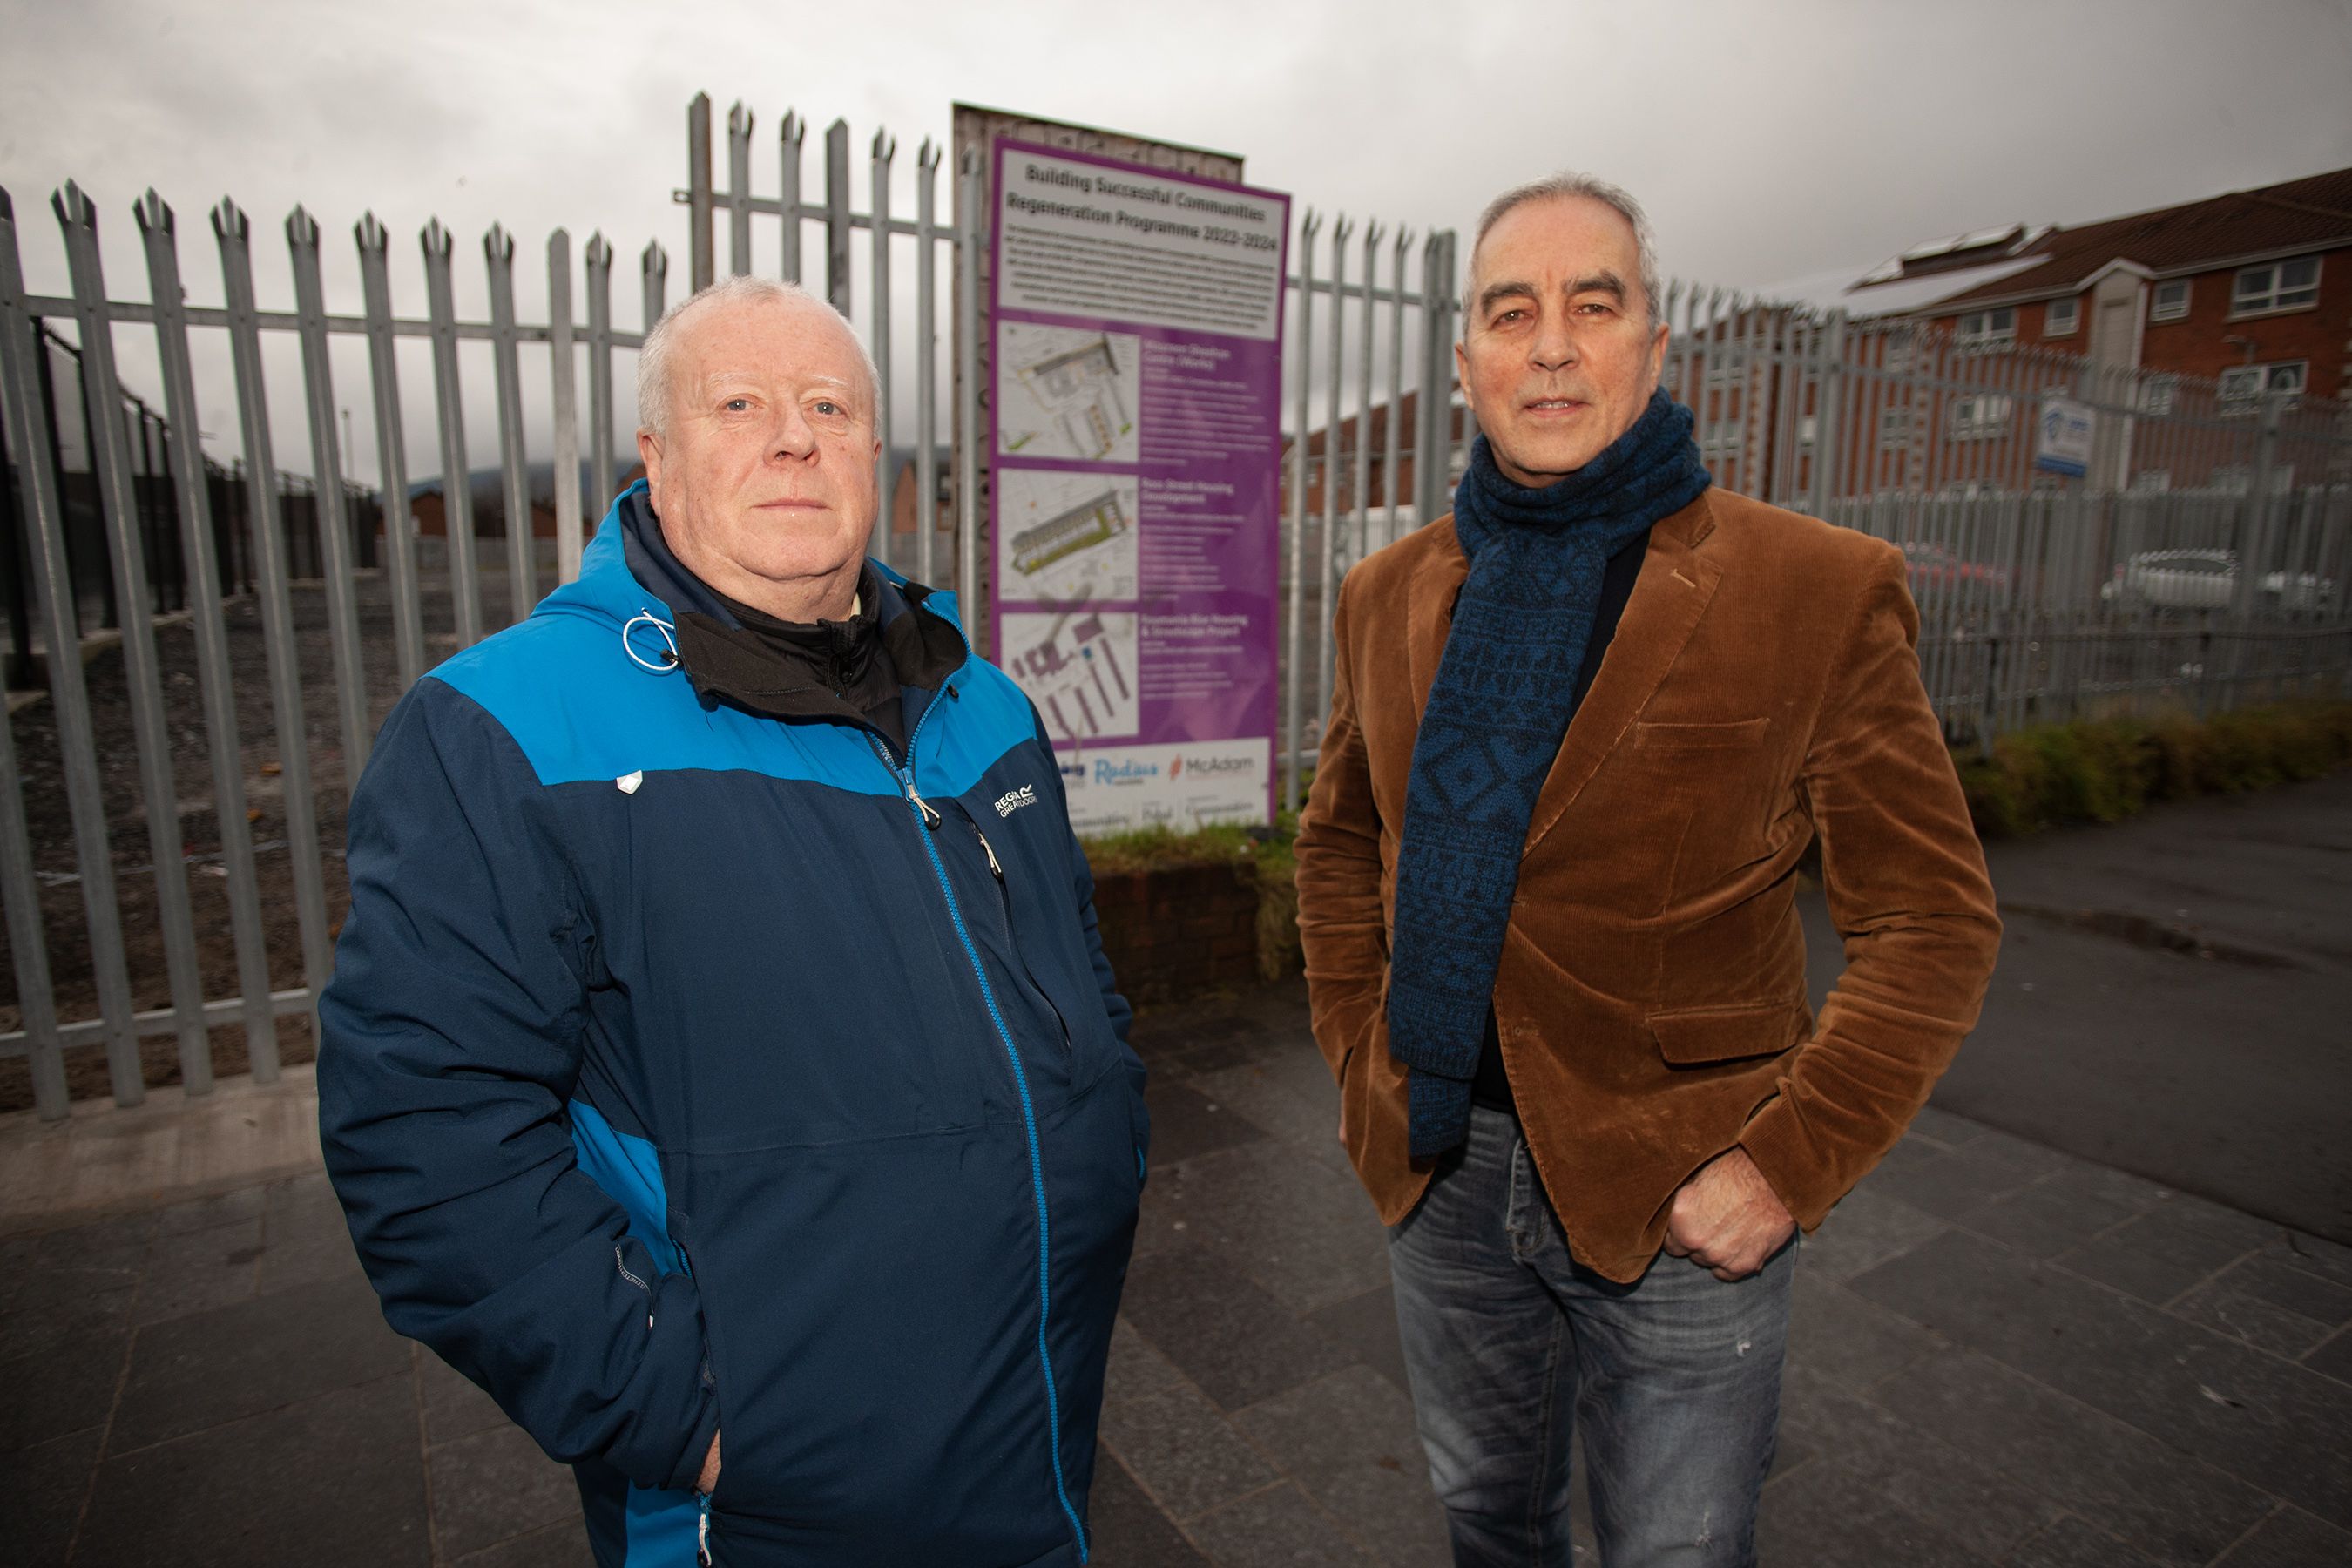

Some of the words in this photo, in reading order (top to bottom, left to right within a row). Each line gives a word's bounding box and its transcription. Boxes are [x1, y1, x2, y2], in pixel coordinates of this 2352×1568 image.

[1006, 191, 1112, 225] Regeneration
[1115, 209, 1200, 240] Programme
[1203, 225, 1278, 251] 2022-2024
[1025, 163, 1092, 193] Building
[1095, 175, 1172, 205] Successful
[1174, 191, 1267, 221] Communities
[1094, 758, 1158, 784] Radius
[1186, 756, 1254, 773] McAdam
